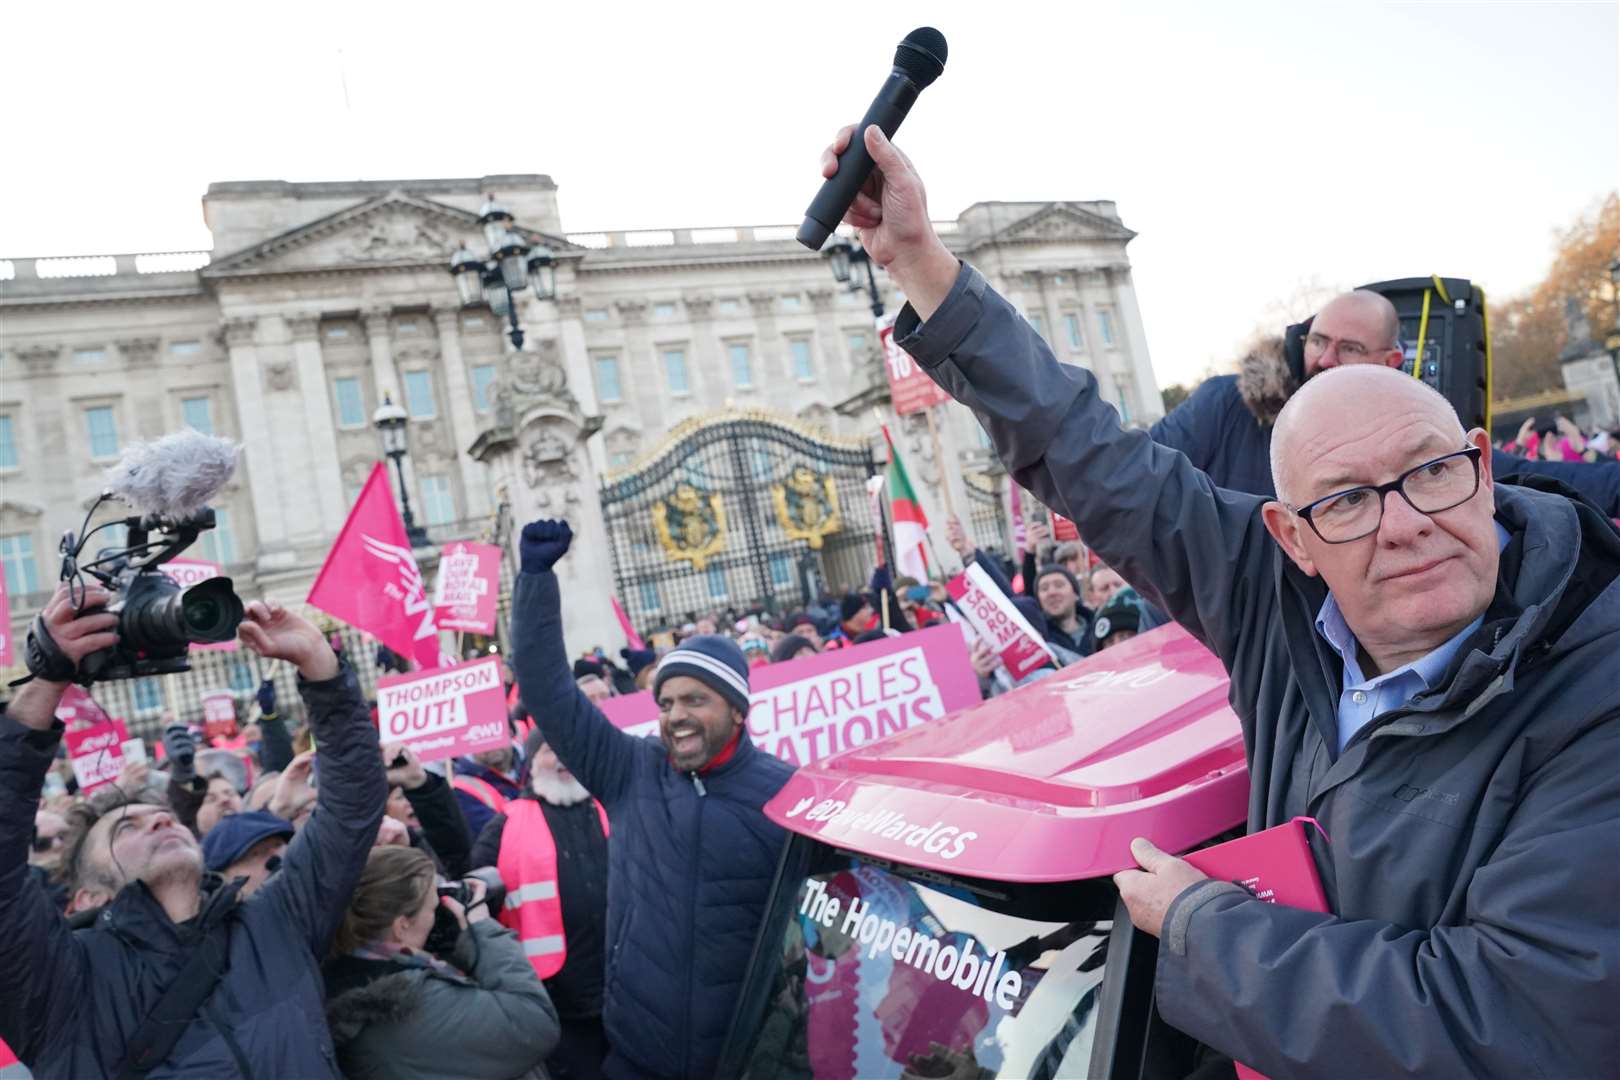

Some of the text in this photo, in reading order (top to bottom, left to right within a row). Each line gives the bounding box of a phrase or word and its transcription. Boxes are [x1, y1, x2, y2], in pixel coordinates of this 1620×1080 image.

[385, 667, 492, 708] THOMPSON
[389, 697, 456, 736] OUT!
[749, 656, 922, 737] CHARLES
[800, 878, 841, 928] The
[841, 896, 1023, 1011] Hopemobile
